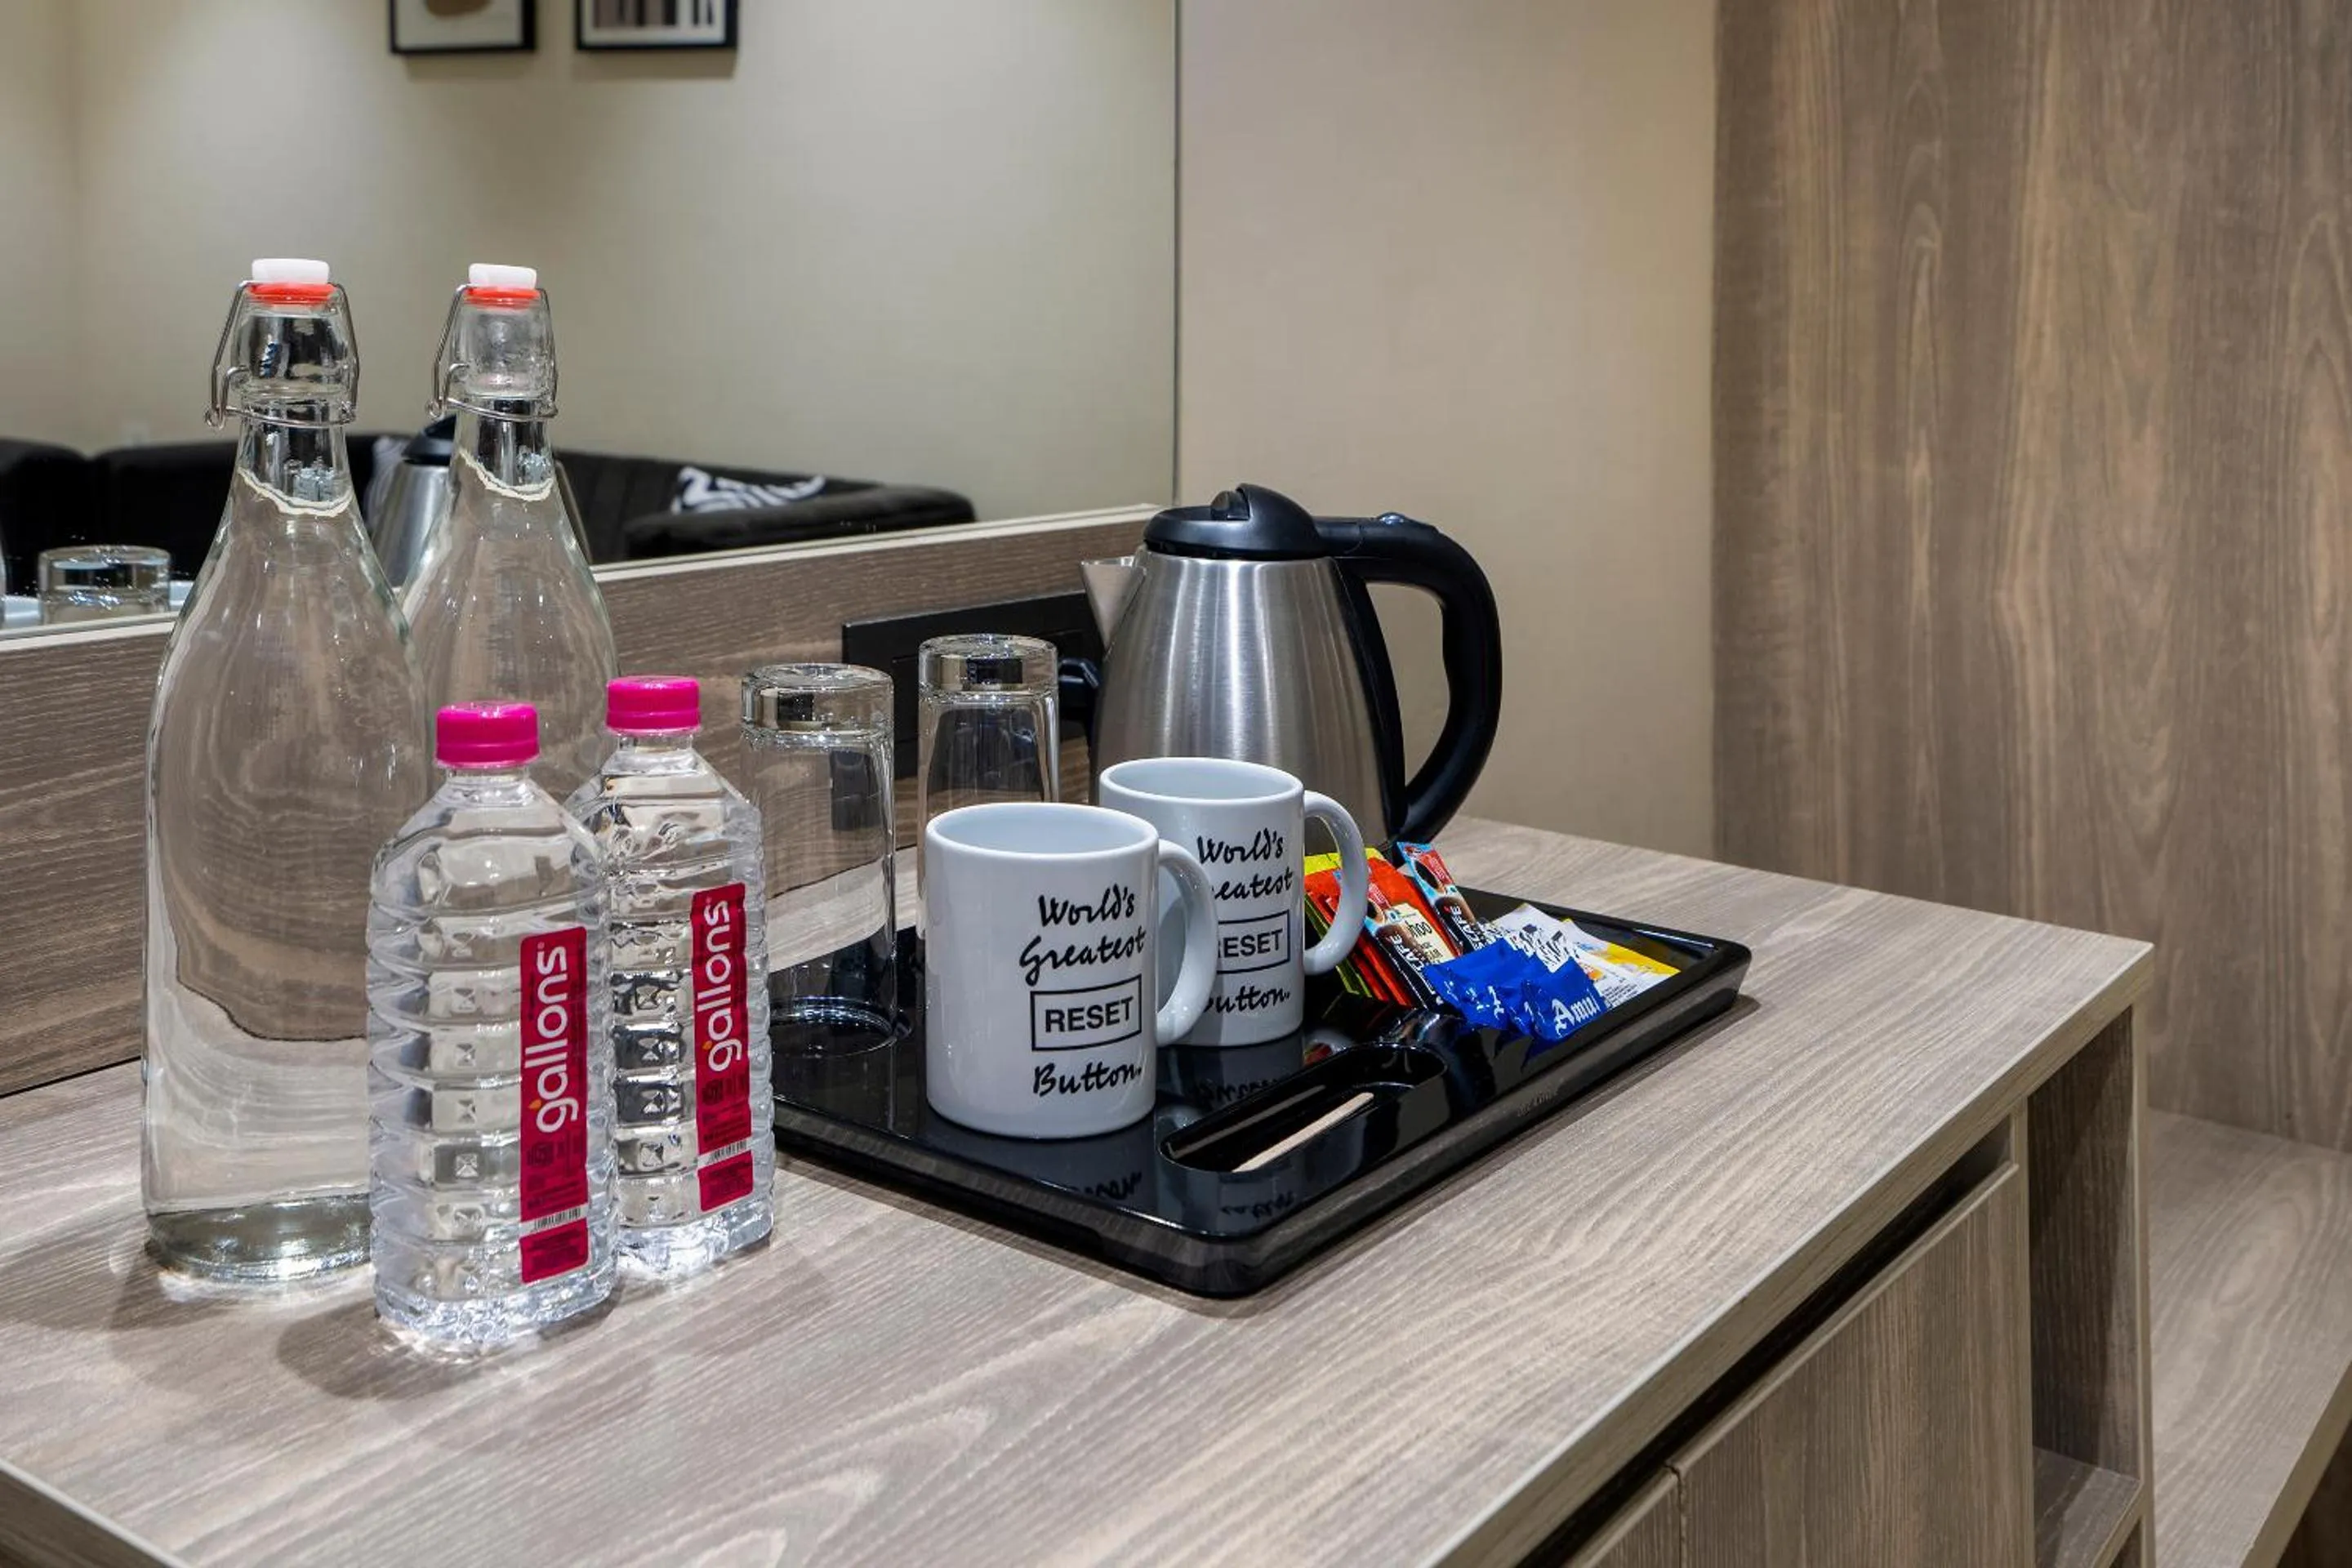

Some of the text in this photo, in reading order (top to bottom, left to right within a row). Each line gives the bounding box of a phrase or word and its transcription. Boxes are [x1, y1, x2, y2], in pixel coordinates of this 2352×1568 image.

[1197, 827, 1284, 864] World's
[1212, 866, 1294, 901] eatest
[1038, 884, 1135, 927] World's
[1019, 925, 1147, 987] Greatest
[1218, 929, 1283, 958] ESET
[697, 900, 742, 1073] gallons
[1045, 996, 1134, 1033] RESET
[1552, 988, 1600, 1039] Amul
[525, 945, 578, 1134] gallons
[1032, 1062, 1143, 1097] Button.
